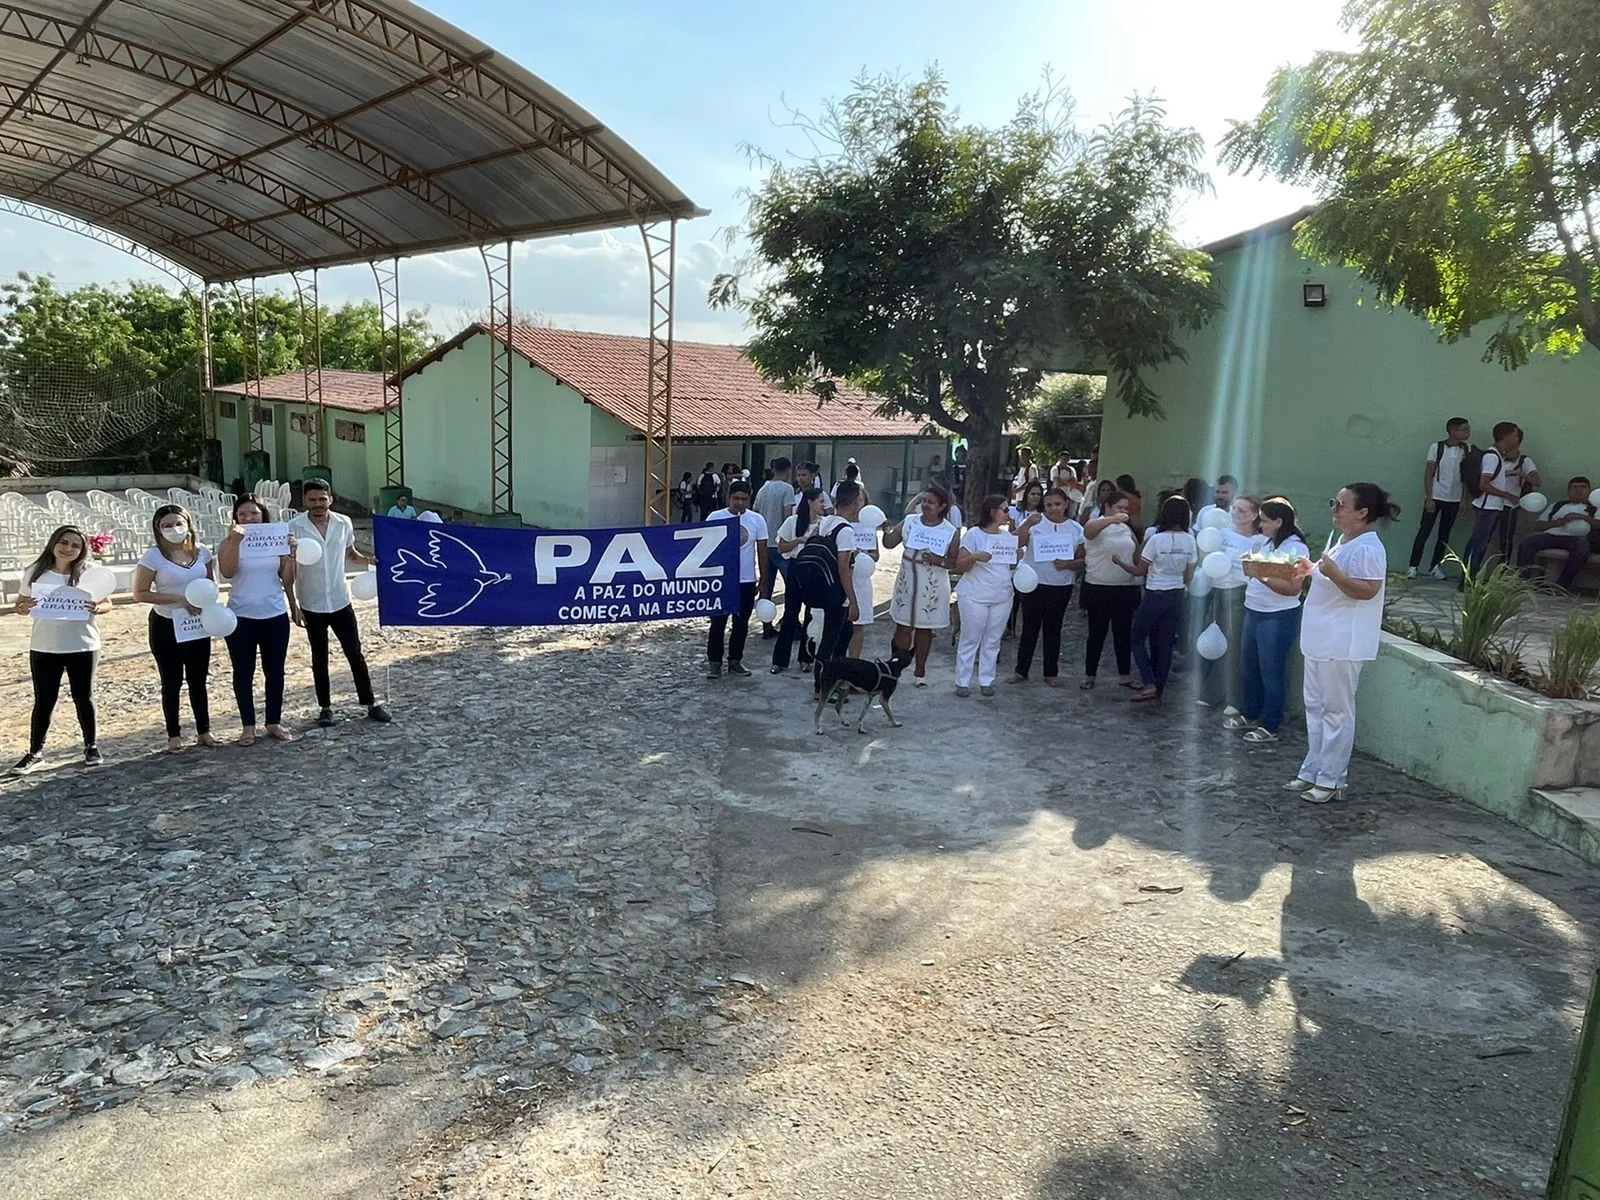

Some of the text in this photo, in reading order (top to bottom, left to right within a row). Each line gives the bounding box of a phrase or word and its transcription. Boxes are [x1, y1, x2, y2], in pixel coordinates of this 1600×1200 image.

[534, 525, 728, 585] PAZ
[574, 579, 723, 600] A PAZ DO MUNDO
[558, 597, 722, 622] COMEÇA NA ESCOLA
